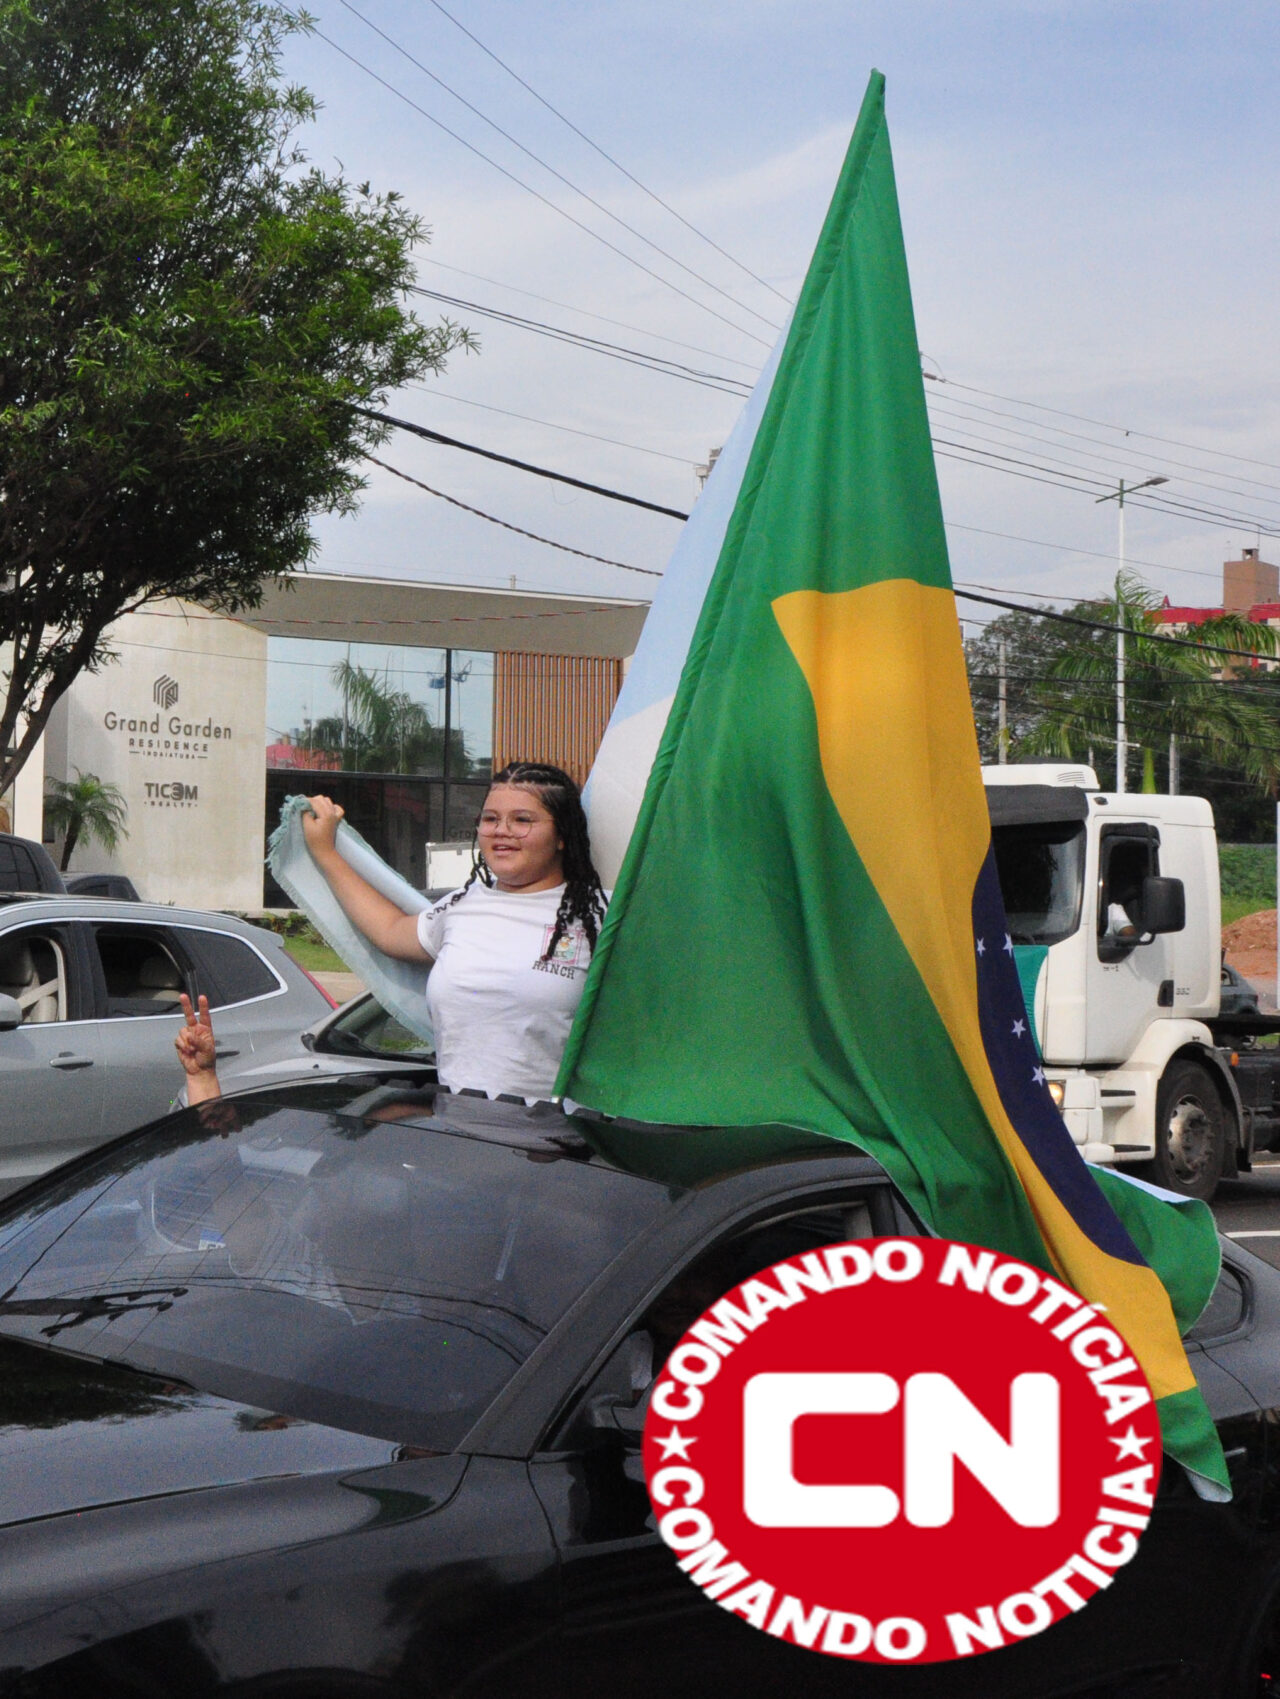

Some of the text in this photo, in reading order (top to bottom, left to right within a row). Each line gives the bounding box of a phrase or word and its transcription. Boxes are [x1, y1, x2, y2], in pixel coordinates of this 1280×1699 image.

[104, 711, 232, 740] Grand Garden
[129, 738, 208, 752] RESIDENCE
[532, 960, 575, 980] RANCH
